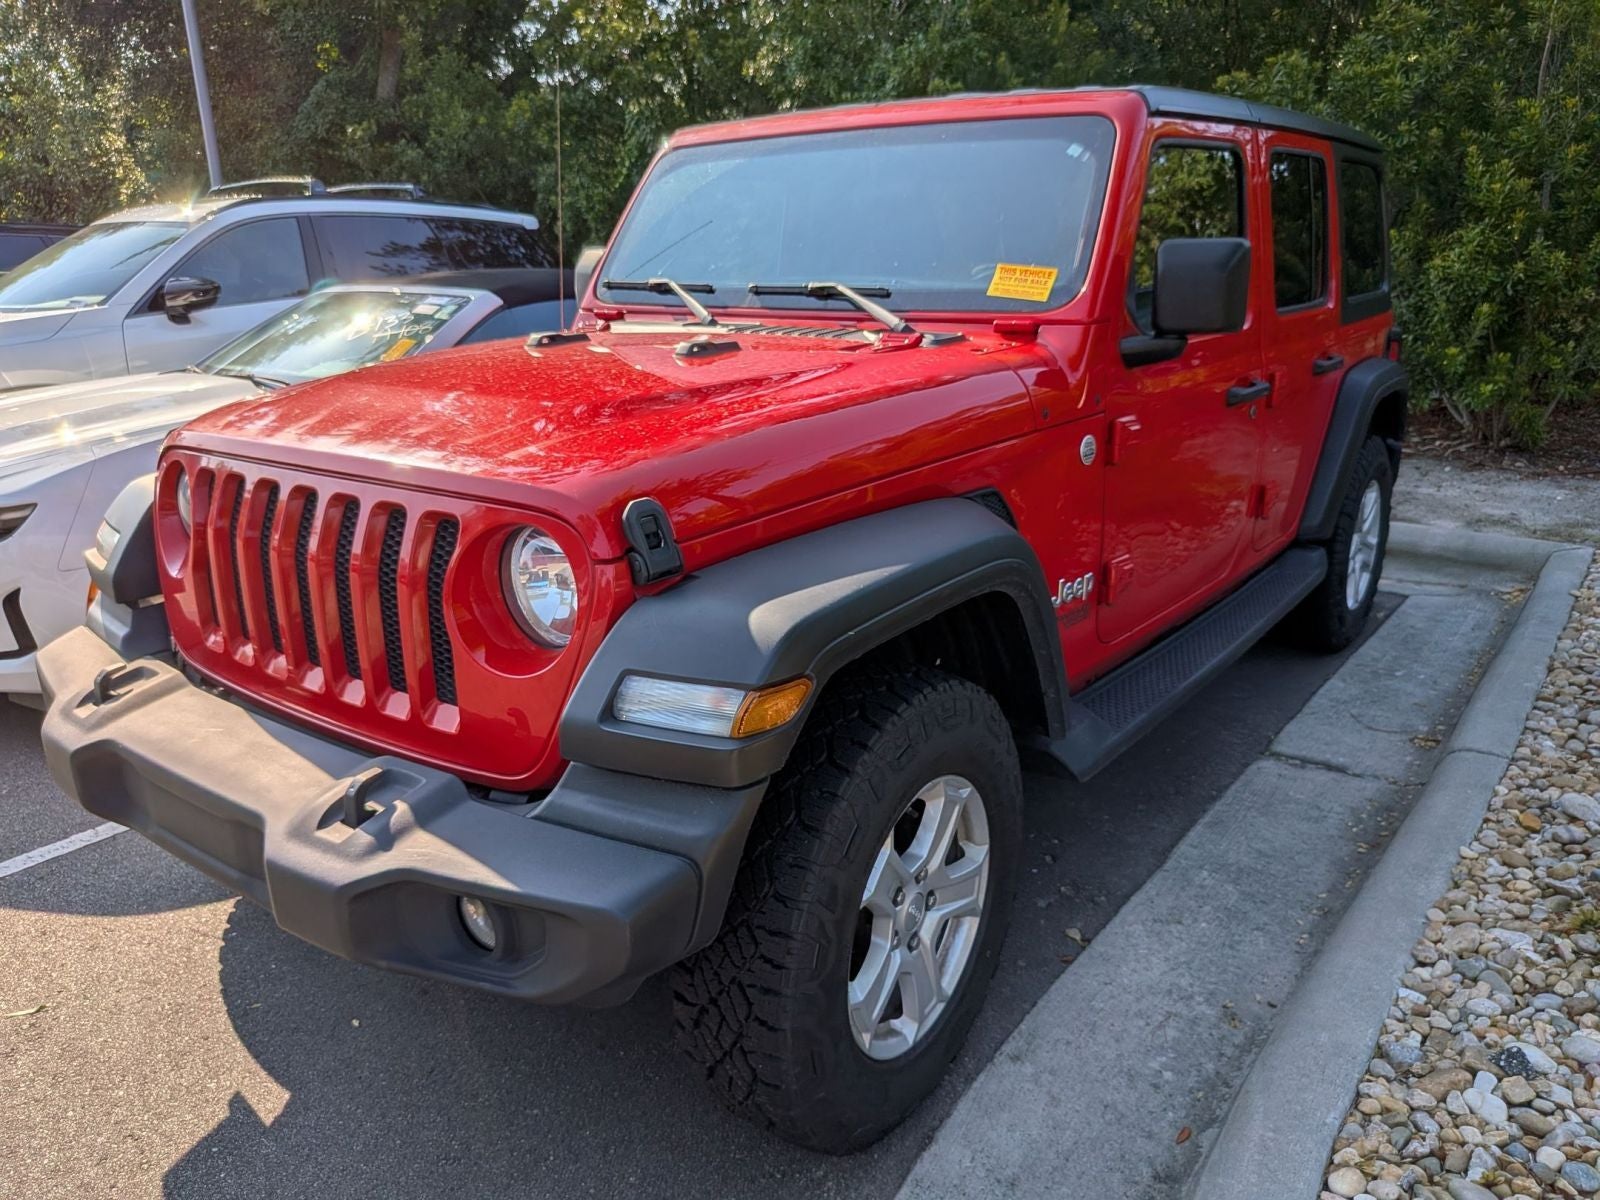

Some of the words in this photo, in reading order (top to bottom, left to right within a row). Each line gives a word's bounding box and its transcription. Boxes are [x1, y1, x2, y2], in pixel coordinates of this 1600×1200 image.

[999, 267, 1018, 275] THIS
[1019, 268, 1053, 279] VEHICLE
[1013, 276, 1029, 284] FOR
[1029, 279, 1049, 287] SALE
[1051, 572, 1094, 608] Jeep
